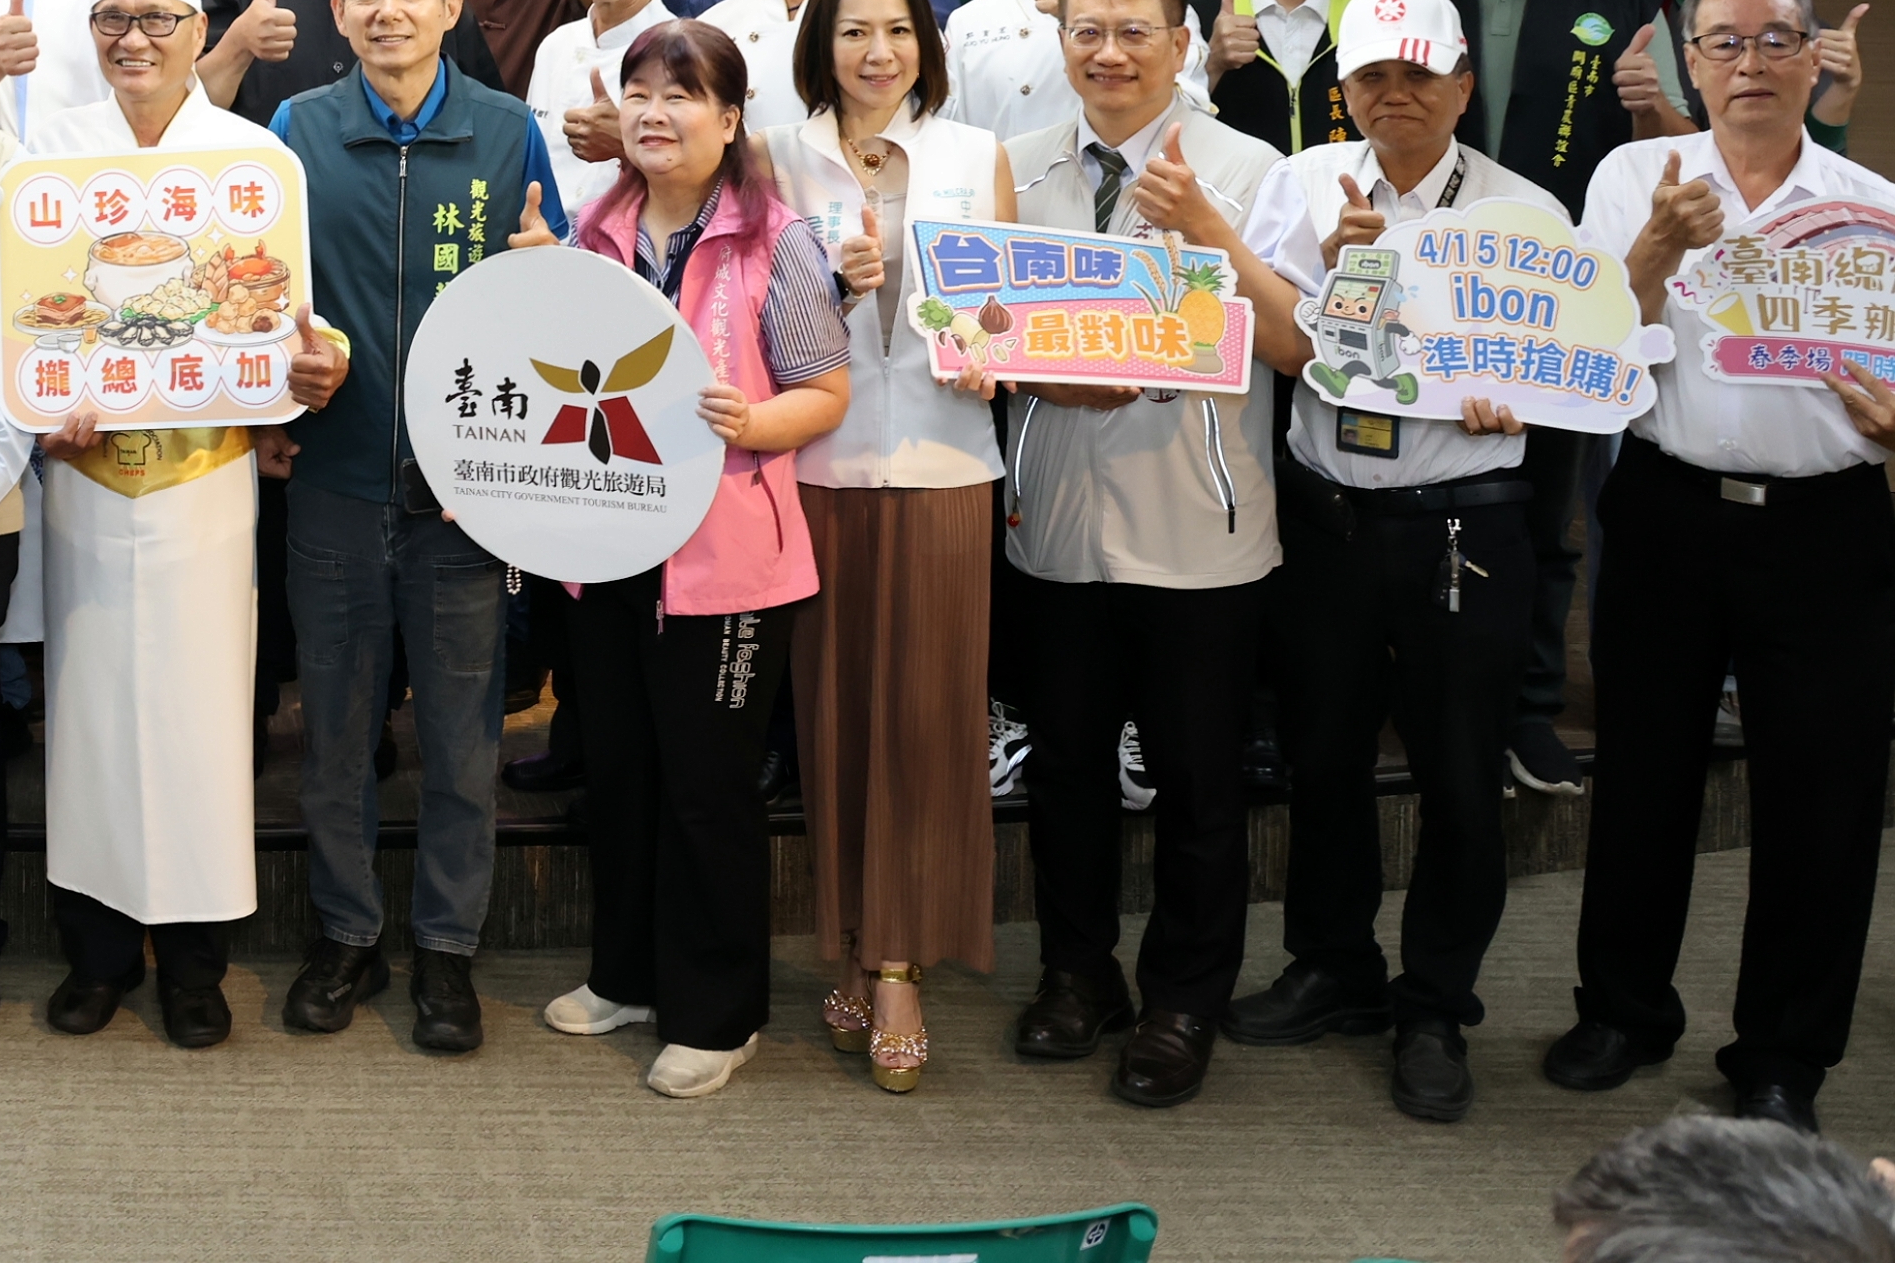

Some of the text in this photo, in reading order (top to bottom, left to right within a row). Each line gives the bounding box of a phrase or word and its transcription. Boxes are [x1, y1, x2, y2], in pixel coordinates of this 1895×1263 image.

[30, 181, 266, 228] 山珍海味
[827, 201, 843, 244] 理事長
[928, 231, 1125, 293] 台南味
[1507, 237, 1596, 287] 12:00
[1721, 235, 1895, 294] 臺南總
[710, 244, 732, 386] 府城文化觀光產
[1454, 275, 1556, 328] ibon
[1025, 309, 1195, 366] 最對味
[1749, 345, 1833, 372] 春季場
[35, 350, 272, 397] 攏總底加
[445, 358, 528, 420] 臺南
[452, 425, 526, 443] TAINAN
[454, 459, 667, 497] 臺南市政府觀光旅遊局
[454, 487, 667, 514] TAINAN CITY GOVERNMENT TOURISM BUREAU
